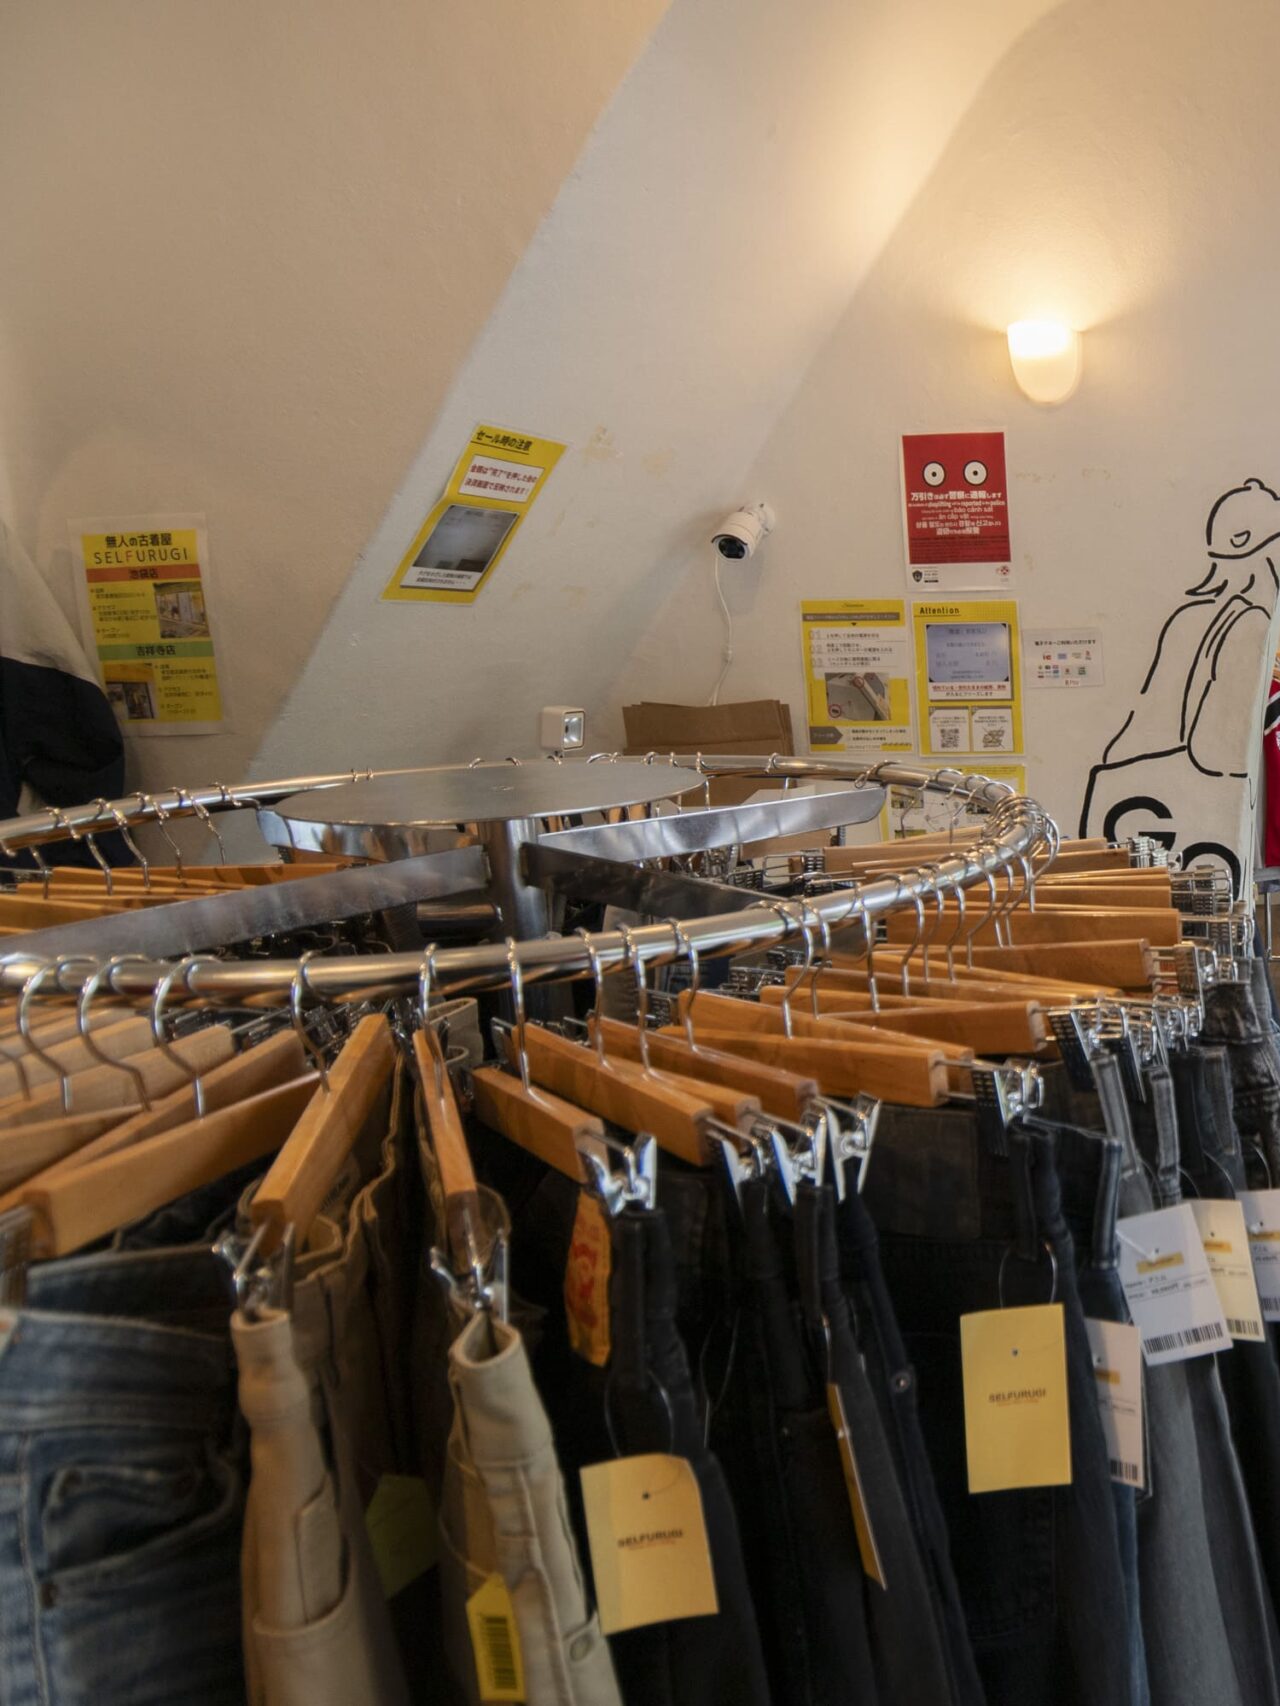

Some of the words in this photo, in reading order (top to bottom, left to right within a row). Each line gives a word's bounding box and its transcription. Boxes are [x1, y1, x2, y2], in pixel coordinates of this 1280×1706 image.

[476, 430, 533, 451] セール時の注意
[105, 533, 172, 548] 無人の古着屋
[94, 548, 188, 564] SELFURUGI
[920, 606, 960, 614] Attention
[136, 645, 176, 656] 吉祥寺店
[989, 1387, 1046, 1403] SELFURUGI
[617, 1529, 684, 1548] SELFURUGI
